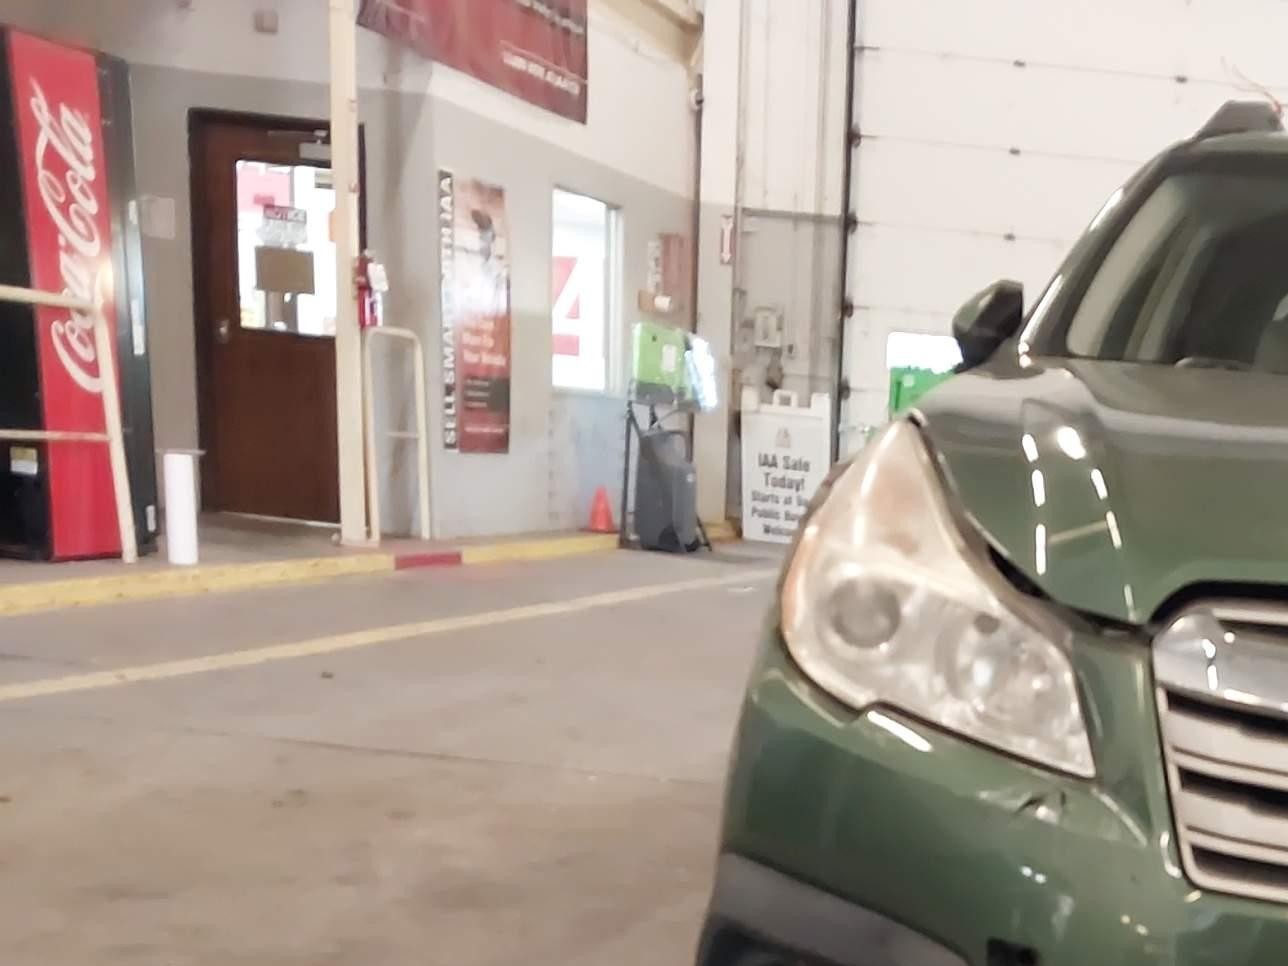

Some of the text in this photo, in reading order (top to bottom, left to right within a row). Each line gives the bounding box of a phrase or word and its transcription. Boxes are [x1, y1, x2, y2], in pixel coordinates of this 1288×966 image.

[29, 78, 104, 393] Coca-Cola
[758, 452, 811, 472] IAA Sale
[763, 473, 806, 492] Today!
